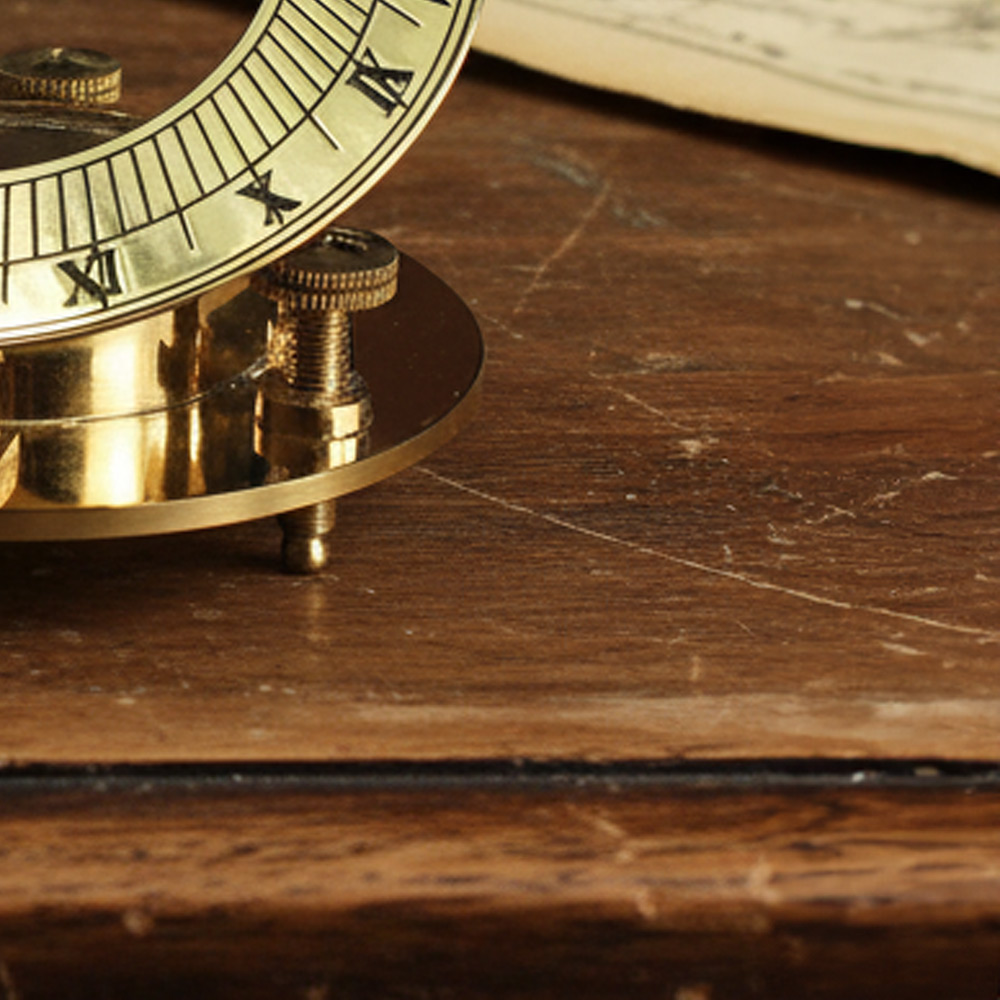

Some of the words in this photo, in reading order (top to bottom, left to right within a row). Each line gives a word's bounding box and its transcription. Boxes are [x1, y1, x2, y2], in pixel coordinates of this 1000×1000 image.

[345, 46, 415, 119] IX
[235, 168, 302, 227] X
[56, 248, 123, 309] XI
